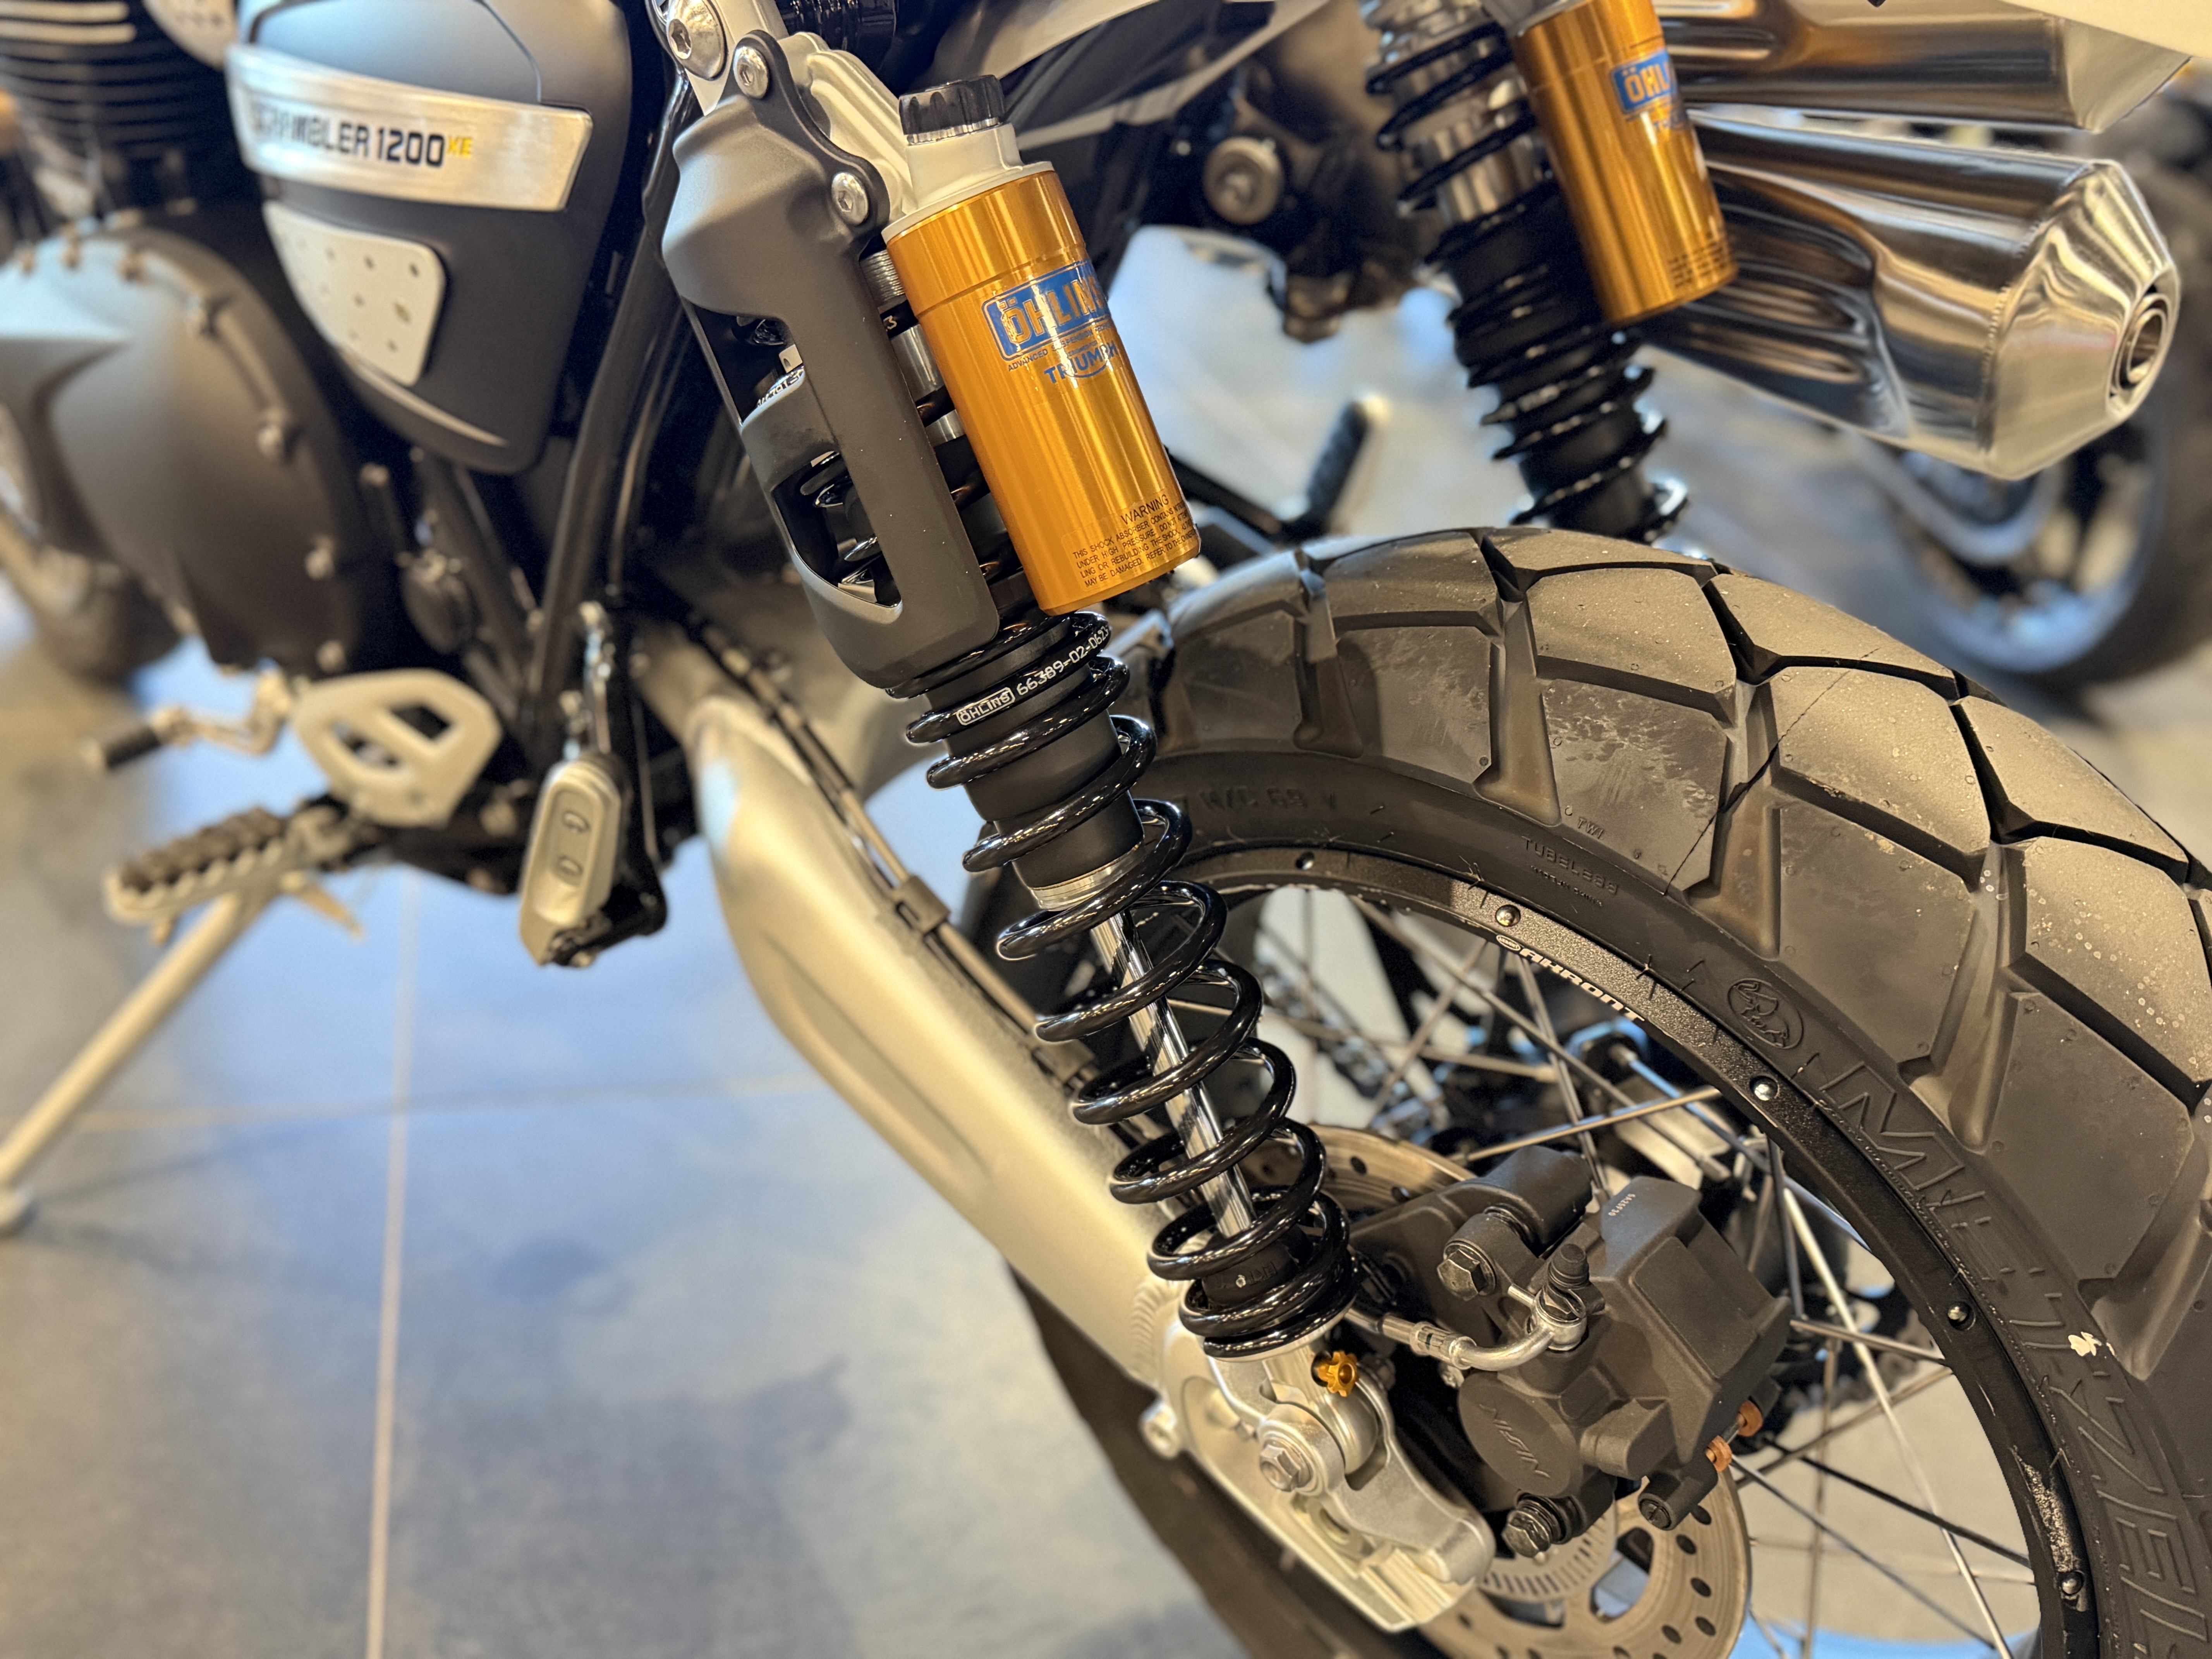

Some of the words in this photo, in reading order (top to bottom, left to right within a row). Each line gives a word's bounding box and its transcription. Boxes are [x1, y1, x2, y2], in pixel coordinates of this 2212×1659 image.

[254, 107, 369, 155] RAMBLER
[379, 129, 445, 167] 1200
[448, 137, 472, 158] XE
[1008, 349, 1048, 371] ADVANCED
[1051, 329, 1092, 350] SSPENSION
[1044, 341, 1118, 383] TRIUMPH
[1121, 494, 1169, 525] WARNING
[1073, 548, 1088, 559] THIS
[1091, 537, 1113, 552] SHOCK
[1116, 521, 1149, 541] ABSORBER
[1077, 555, 1099, 569] UNDER
[1101, 547, 1119, 559] HIGH
[1159, 522, 1168, 532] DO
[1080, 567, 1096, 579] LING
[1097, 562, 1109, 571] OR
[1111, 543, 1149, 565] REBUILDING
[1150, 536, 1162, 548] THE
[1162, 528, 1180, 541] SHOCK
[1085, 576, 1099, 587] MAY
[1098, 572, 1109, 582] BE
[1146, 546, 1165, 561] REFER
[1164, 542, 1173, 551] TO
[1577, 817, 1604, 839] TWI
[1522, 835, 1619, 895] TUBELESS
[1520, 948, 1645, 1022] AKRONT
[1819, 1062, 2209, 1659] METZEL
[1479, 1404, 1551, 1479] NISSIN
